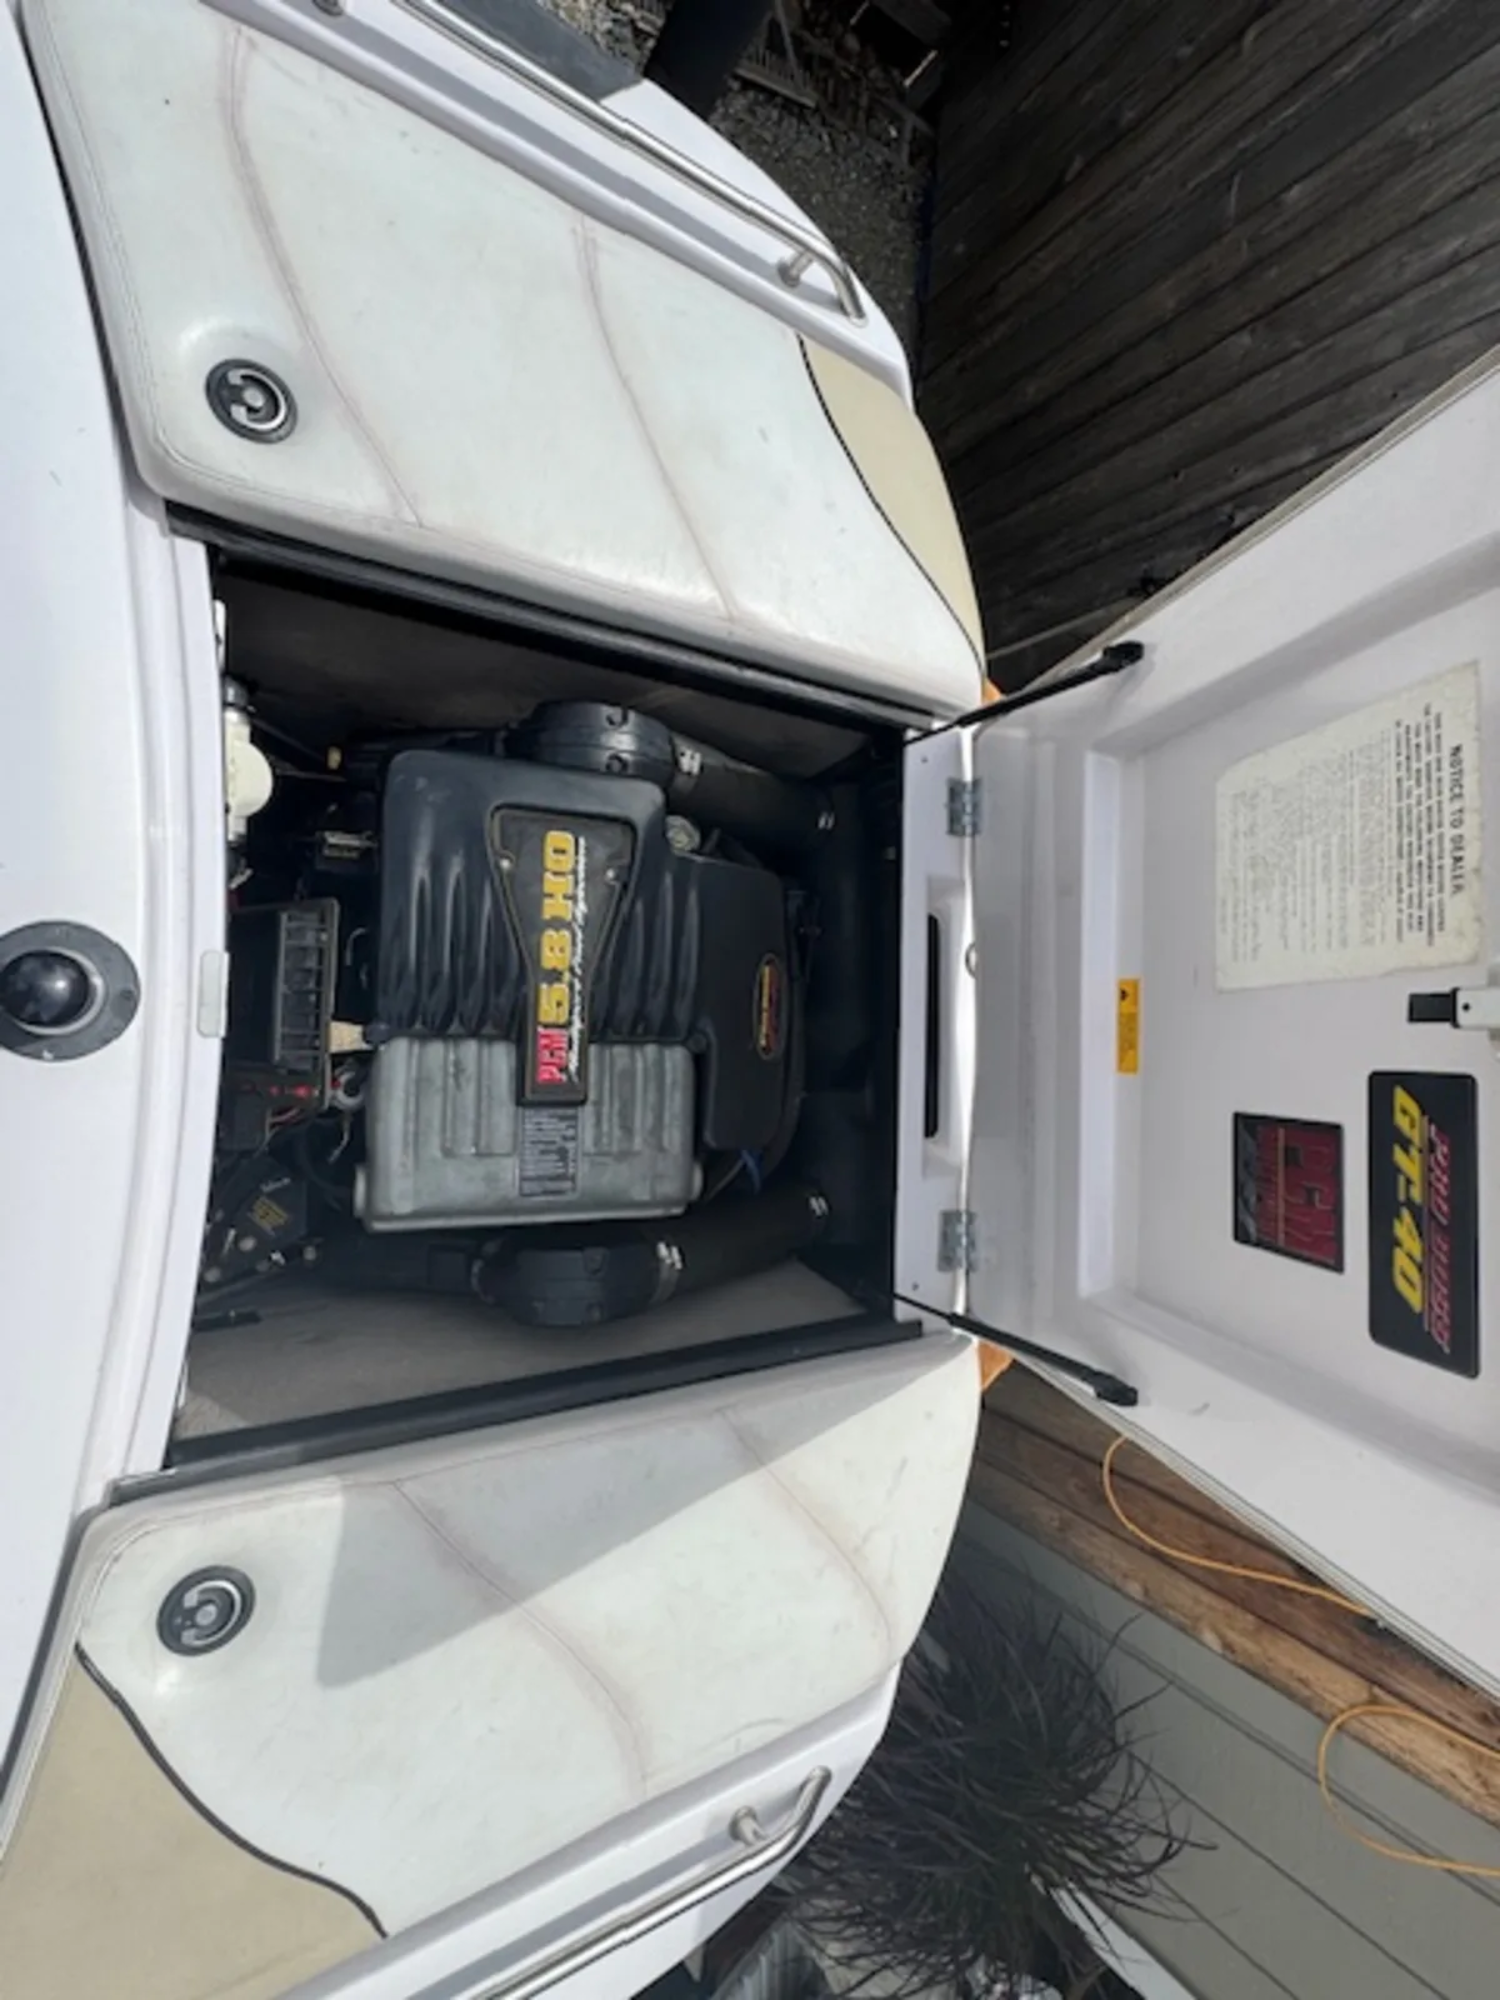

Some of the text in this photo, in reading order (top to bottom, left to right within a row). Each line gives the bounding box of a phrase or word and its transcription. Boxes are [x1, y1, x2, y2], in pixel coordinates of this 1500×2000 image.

[1449, 743, 1465, 895] NOTICE TO DEALER
[543, 829, 575, 920] HO
[537, 928, 573, 1025] 5.8
[536, 1025, 568, 1083] PCM
[1392, 1084, 1423, 1315] GT-40
